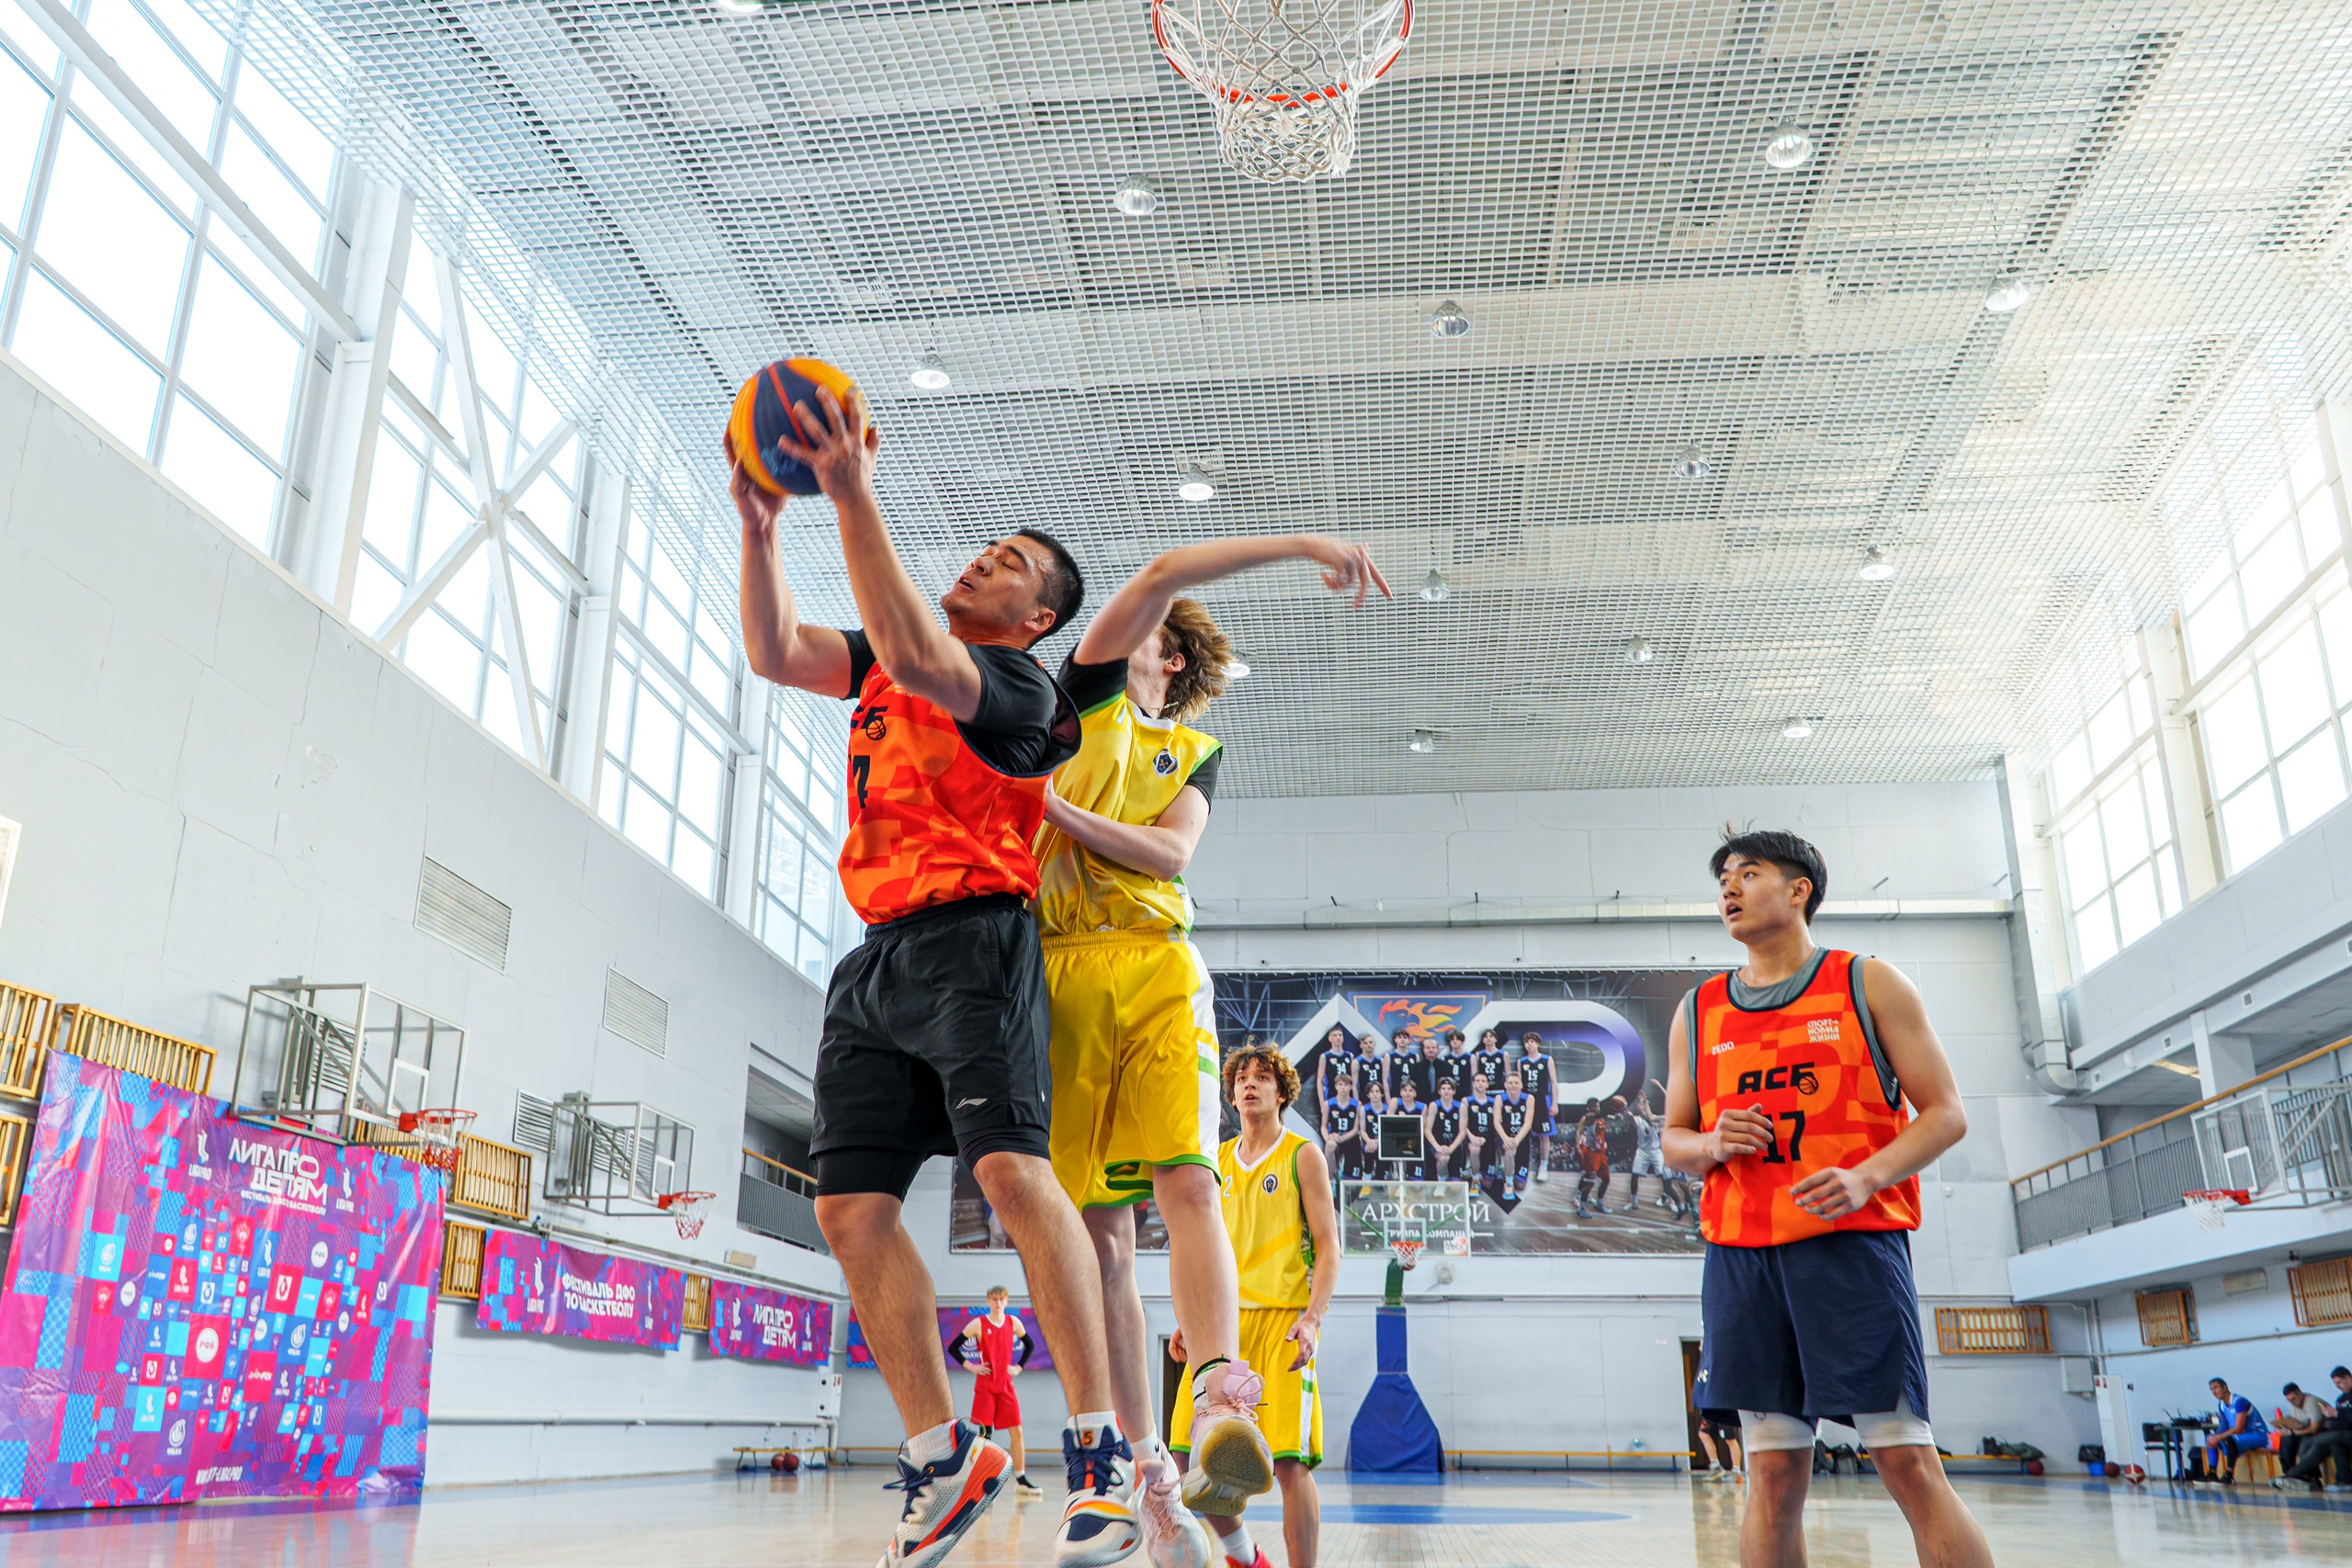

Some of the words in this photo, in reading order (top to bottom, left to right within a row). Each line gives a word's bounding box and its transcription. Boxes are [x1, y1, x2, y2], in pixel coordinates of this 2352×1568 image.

[1402, 1063, 1409, 1074] 4
[1485, 1062, 1496, 1074] 22
[1527, 1069, 1539, 1081] 15
[1338, 1118, 1349, 1131] 13
[1444, 1120, 1452, 1133] 5
[1510, 1112, 1521, 1125] 12
[1762, 1110, 1806, 1164] 17
[228, 1137, 277, 1171] ЛИГА
[277, 1148, 320, 1179] ПРО
[250, 1167, 328, 1205] ДЕТЯМ
[1222, 1175, 1233, 1198] 2
[1362, 1201, 1491, 1223] АРХСТРОЙ
[561, 1272, 615, 1301] ФЕСТИВАЛЬ
[615, 1283, 636, 1302] ДФО
[762, 1325, 797, 1349] ДЕТЯМ
